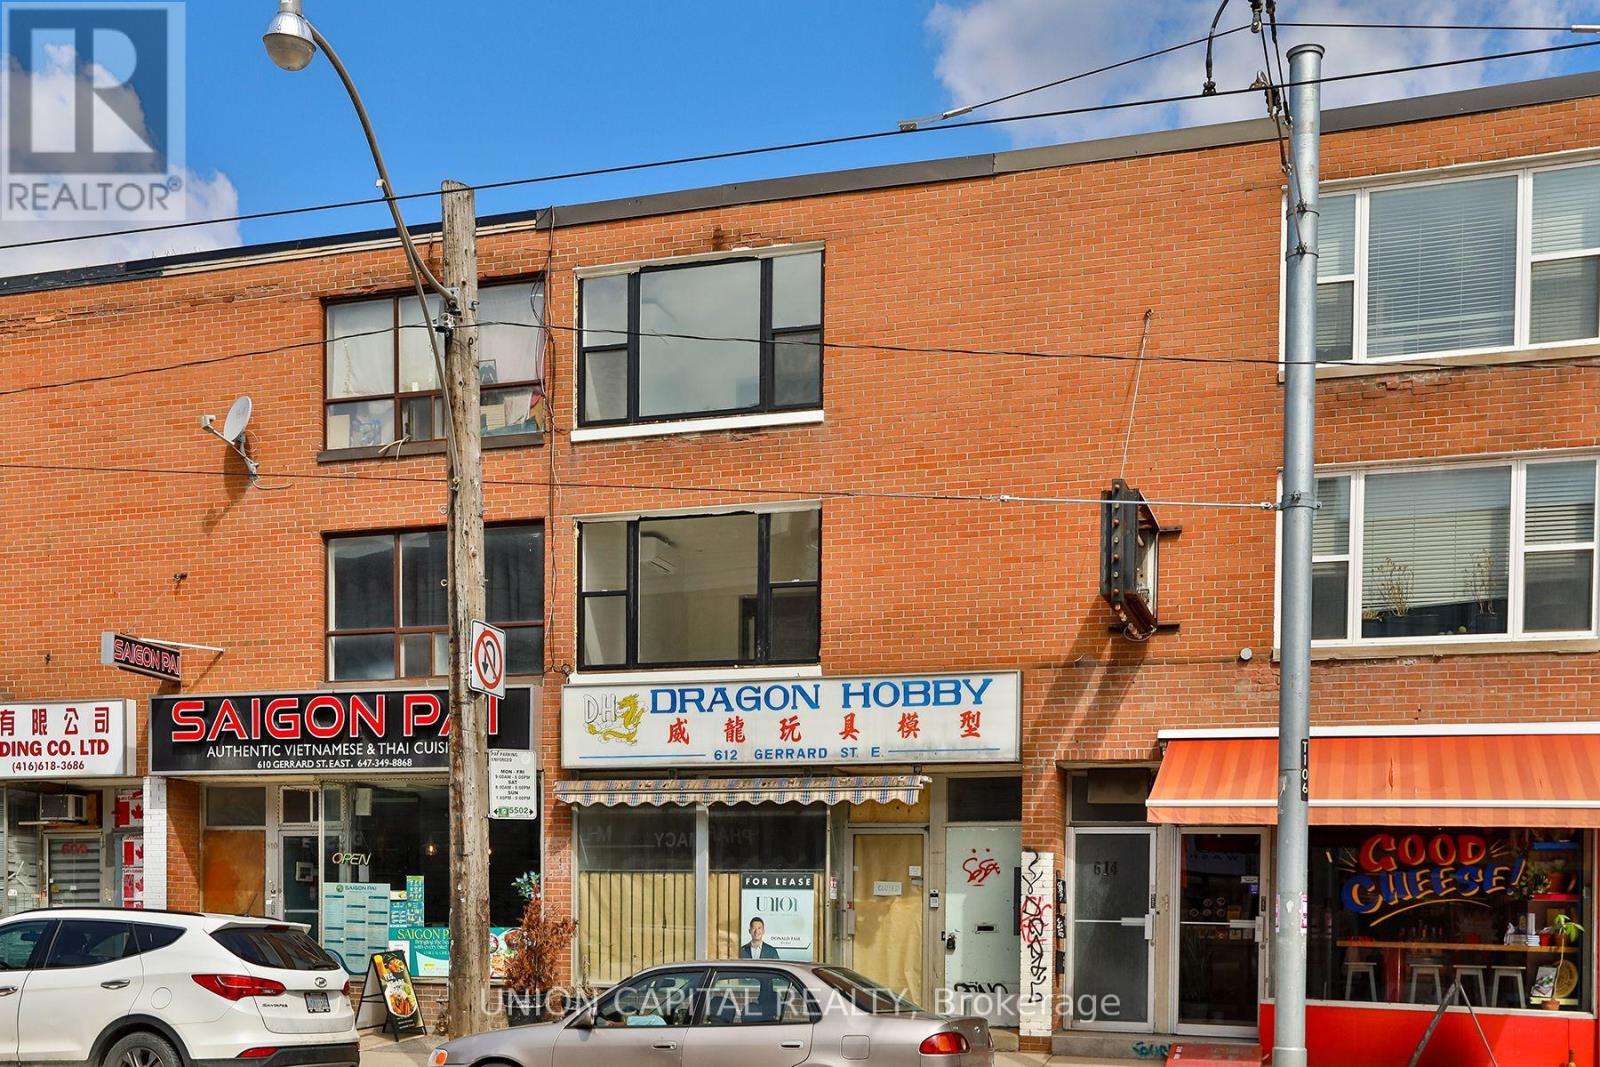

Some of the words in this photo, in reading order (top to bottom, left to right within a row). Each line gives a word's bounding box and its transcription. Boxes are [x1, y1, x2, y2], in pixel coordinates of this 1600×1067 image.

[114, 639, 160, 670] SAIGON
[161, 651, 180, 675] PAI
[650, 684, 820, 714] DRAGON
[842, 678, 993, 709] HOBBY
[171, 694, 386, 742] SAIGON
[403, 694, 498, 736] PI
[667, 711, 981, 745] 威龍玩具模型
[47, 740, 76, 756] CO.
[80, 739, 109, 756] LTD
[207, 744, 281, 758] AUTHENTIC
[285, 743, 364, 757] VIETNAMESE
[367, 743, 376, 755] &
[379, 742, 409, 755] THAI
[714, 750, 738, 761] 612
[754, 747, 828, 760] GERRARD
[12, 760, 85, 773] (416)618-3686
[257, 760, 271, 769] 610
[272, 760, 313, 769] GERRARD
[357, 758, 413, 768] 647-349-8868
[509, 806, 529, 814] 5502
[332, 851, 372, 866] OPEN
[1360, 833, 1486, 872] GOOD
[1094, 860, 1118, 877] 614
[745, 877, 768, 886] FOR
[775, 877, 811, 886] LEASE
[1341, 856, 1527, 913] CHEESE!
[397, 928, 442, 940] SAIGON
